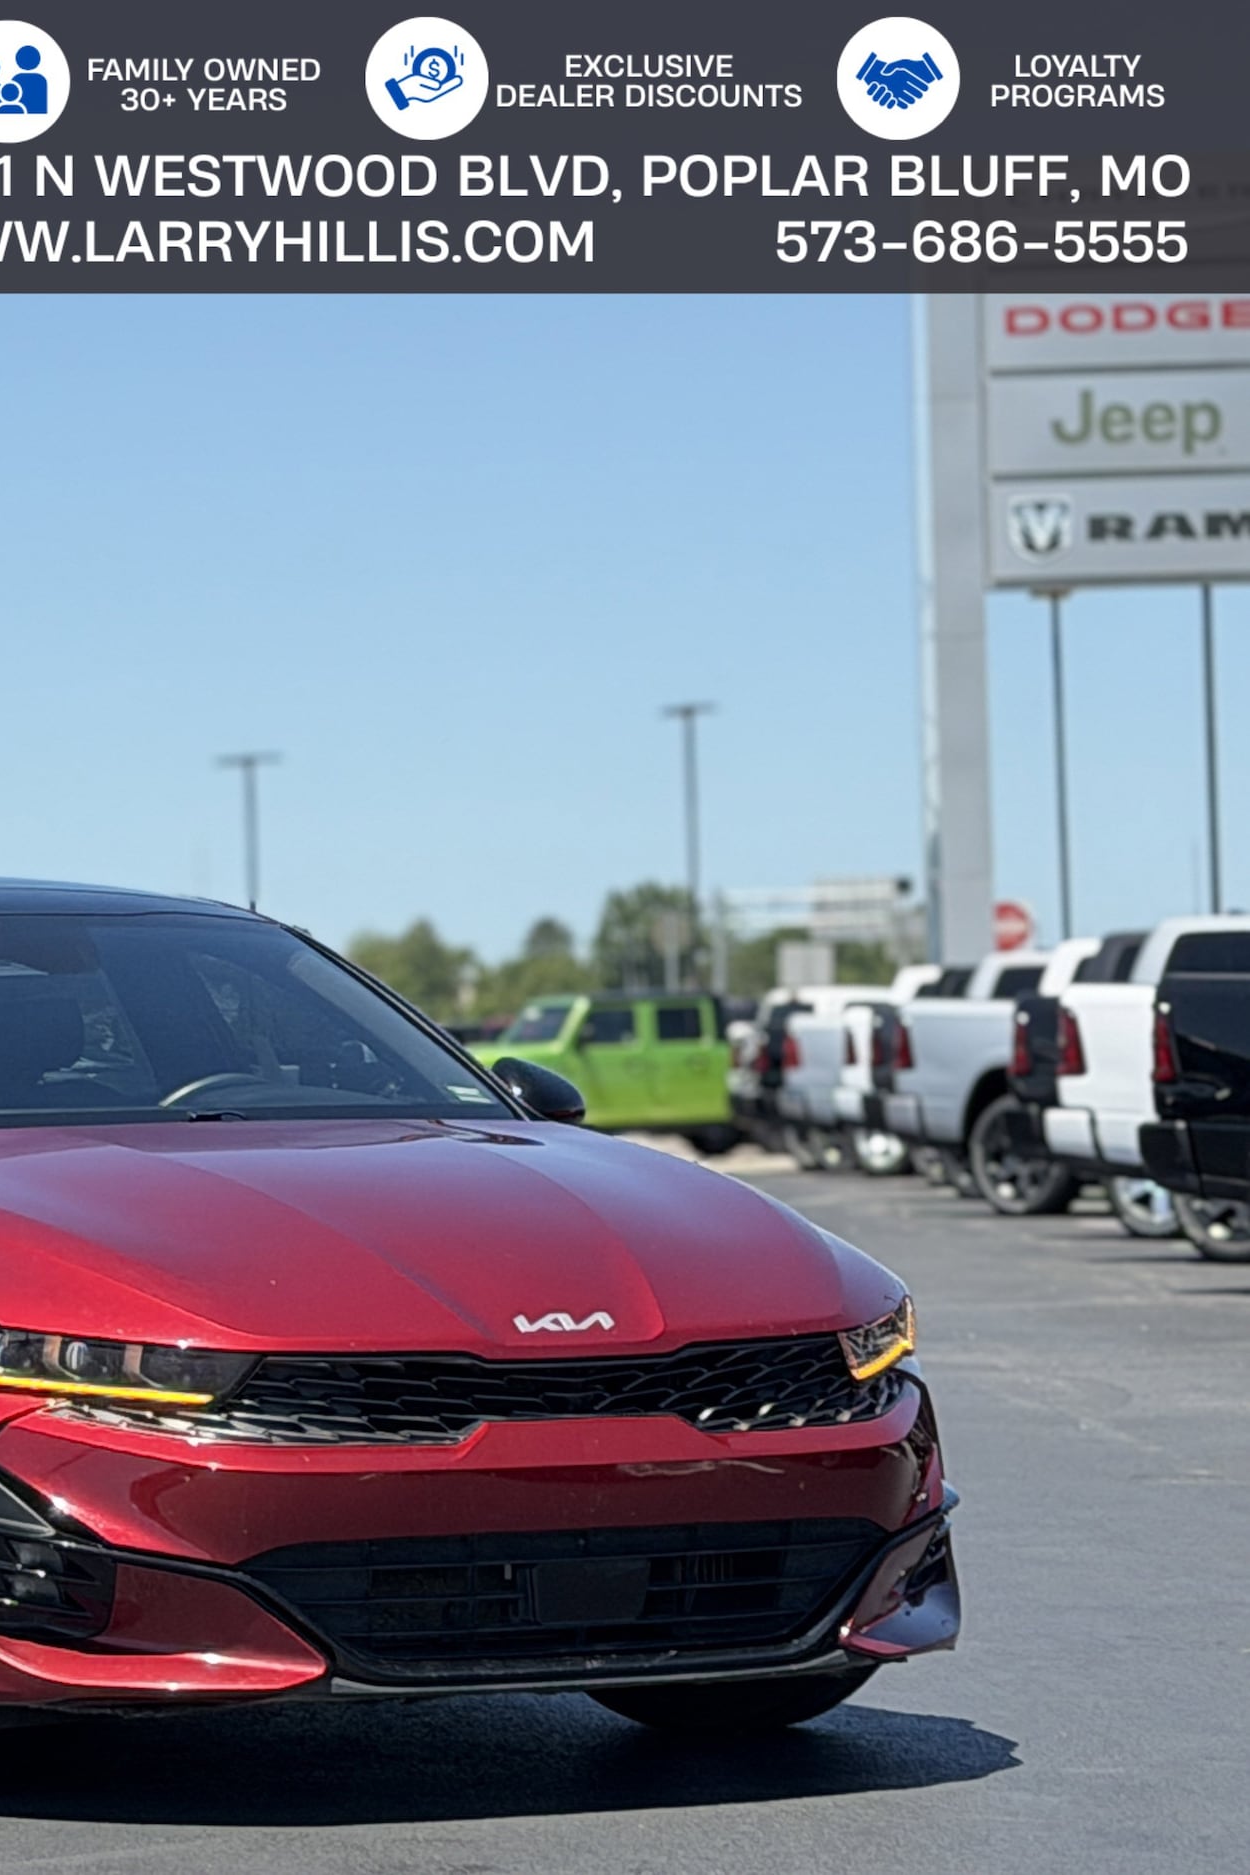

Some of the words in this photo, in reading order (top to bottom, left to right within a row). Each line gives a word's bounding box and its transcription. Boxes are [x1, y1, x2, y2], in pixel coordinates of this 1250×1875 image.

[1004, 300, 1250, 337] DODGE
[1051, 388, 1223, 457] Jeep
[1087, 509, 1250, 542] RAM
[513, 1311, 615, 1334] KIA
